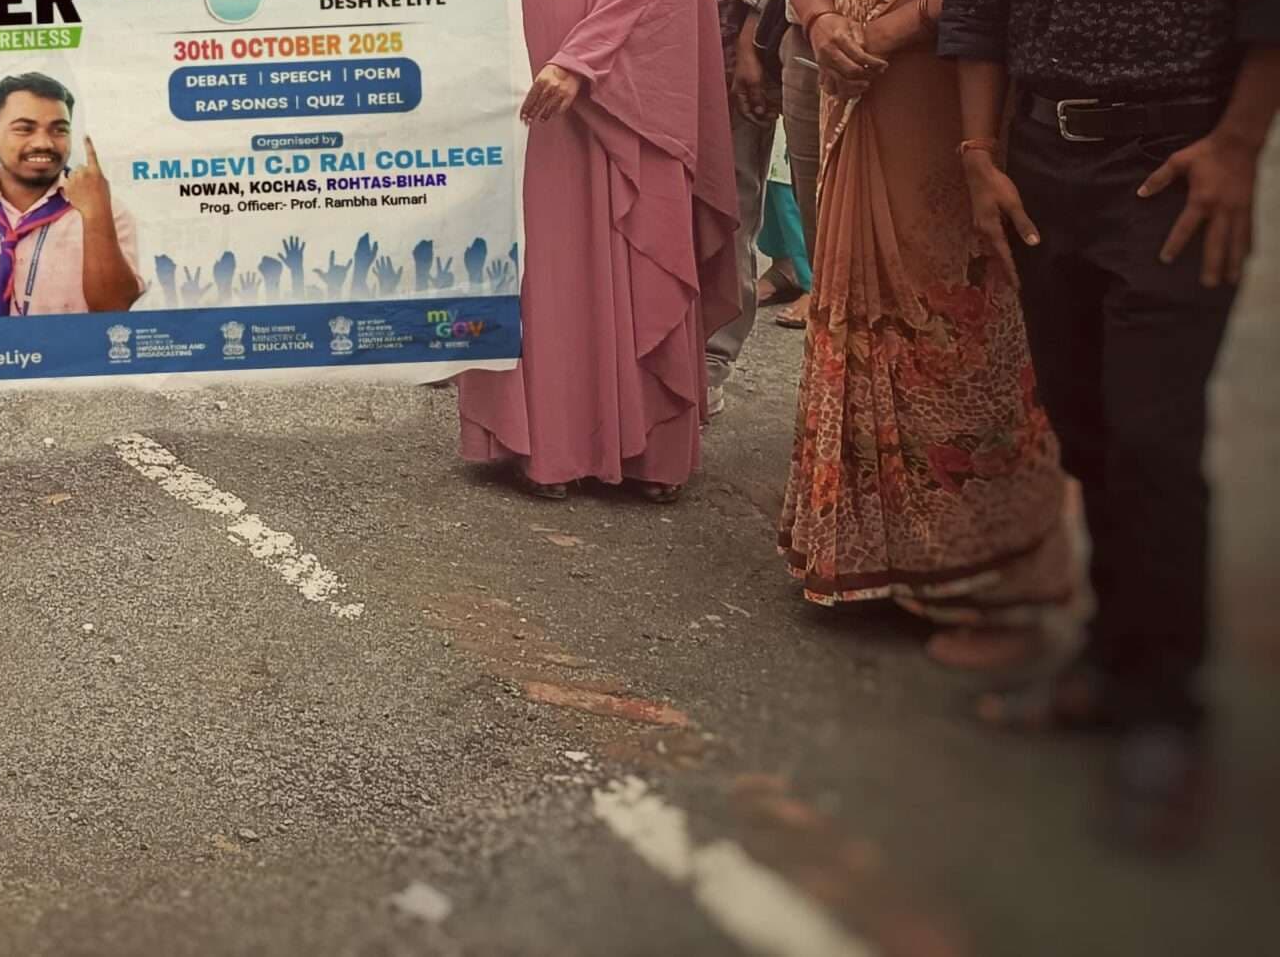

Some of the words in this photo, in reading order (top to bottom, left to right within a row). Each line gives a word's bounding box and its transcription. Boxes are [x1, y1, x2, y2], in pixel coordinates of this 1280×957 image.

[173, 39, 224, 61] 30th
[231, 34, 342, 59] OCTOBER
[349, 31, 403, 55] 2025
[186, 73, 248, 88] DEBATE
[270, 70, 331, 84] SPEECH
[354, 67, 401, 80] POEM
[195, 99, 227, 113] RAP
[231, 97, 288, 111] SONGS
[306, 94, 345, 108] QUIZ
[368, 92, 404, 105] REEL
[322, 133, 337, 146] by
[132, 156, 255, 180] R.M.DEVI
[265, 154, 310, 174] C.D
[320, 151, 365, 172] RAI
[375, 146, 503, 170] COLLEGE
[179, 182, 244, 197] NOWAN,
[250, 178, 321, 194] KOCHAS,
[326, 173, 447, 191] ROHTAS-BIHAR
[200, 202, 233, 215] Prog.
[291, 197, 320, 210] Prof.
[325, 195, 377, 208] Rambha
[382, 193, 427, 206] Kumari
[252, 341, 314, 352] EDUCATION
